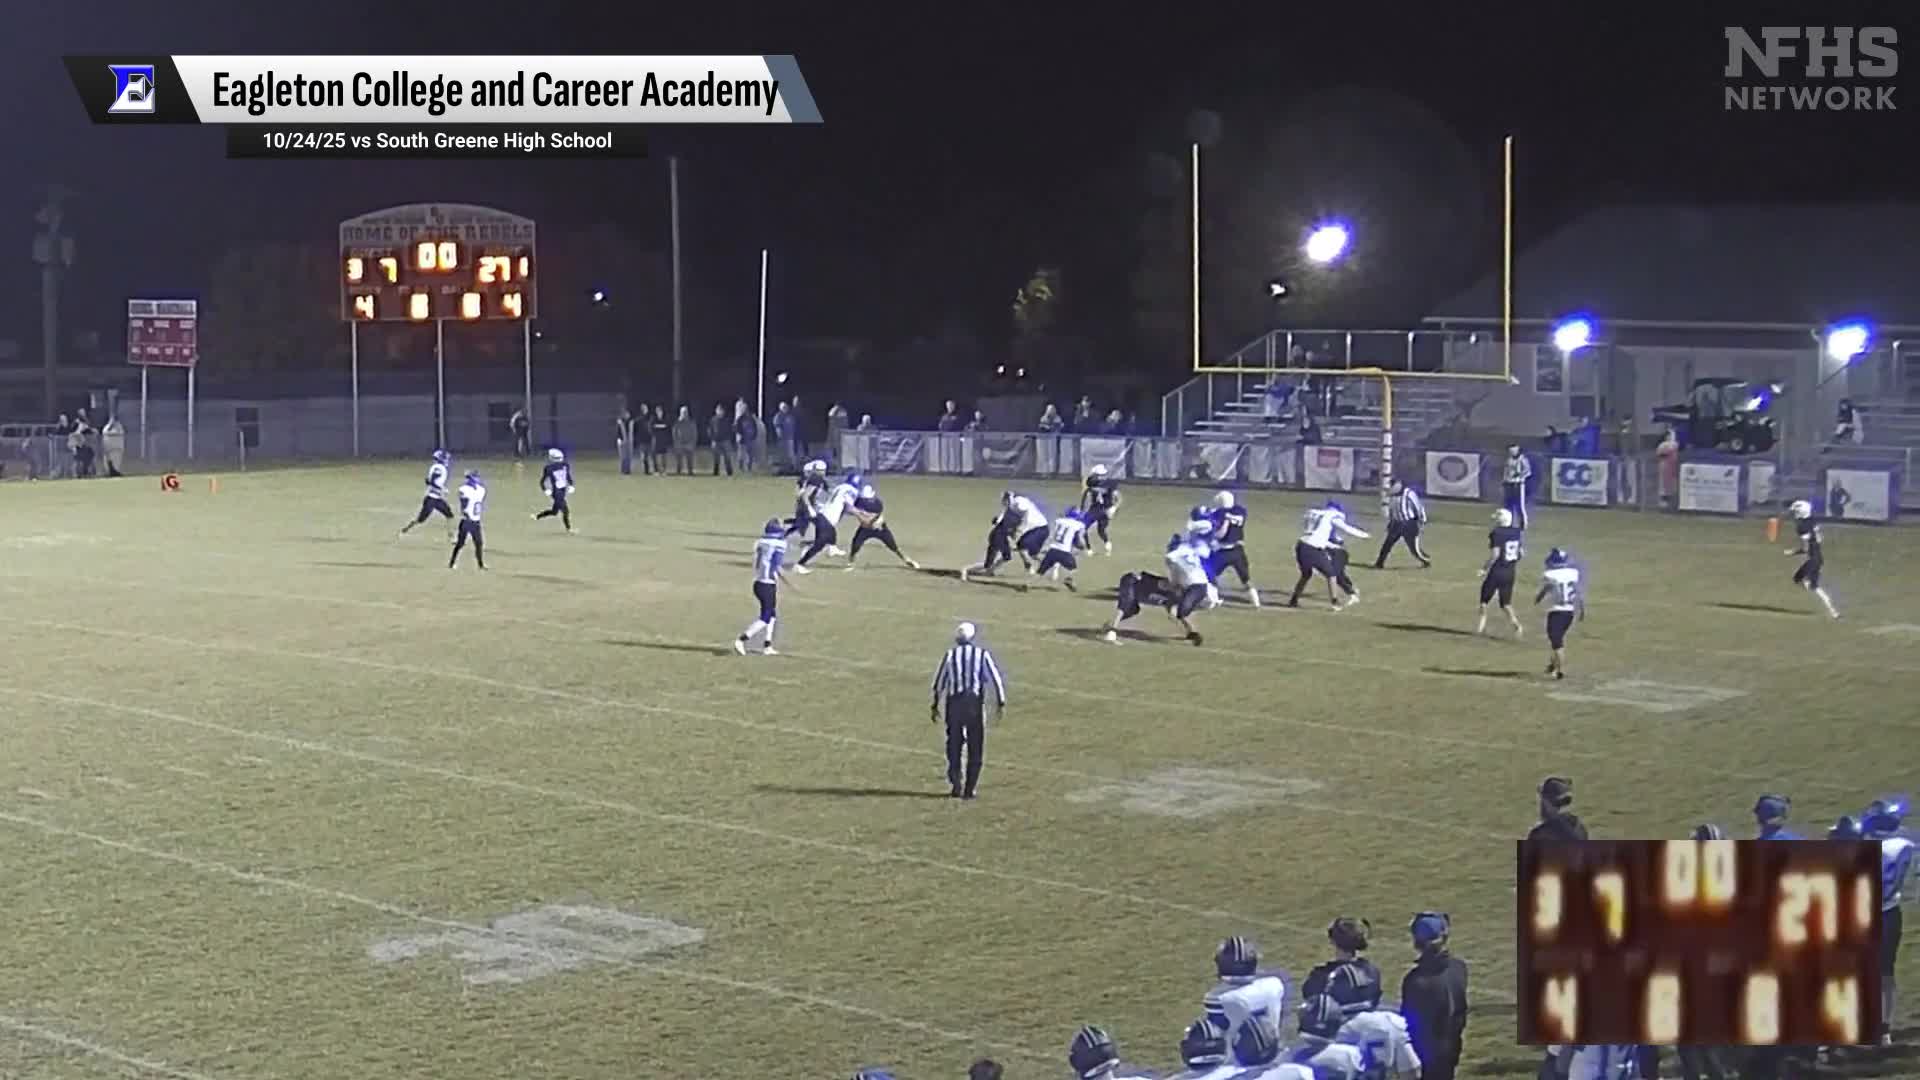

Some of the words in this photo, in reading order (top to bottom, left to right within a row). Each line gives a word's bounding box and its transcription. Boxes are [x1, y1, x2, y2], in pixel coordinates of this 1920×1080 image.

[418, 242, 457, 269] 00
[519, 256, 529, 277] 1
[379, 257, 397, 283] 7
[479, 256, 511, 283] 27
[355, 295, 374, 319] 4
[503, 293, 522, 318] 4
